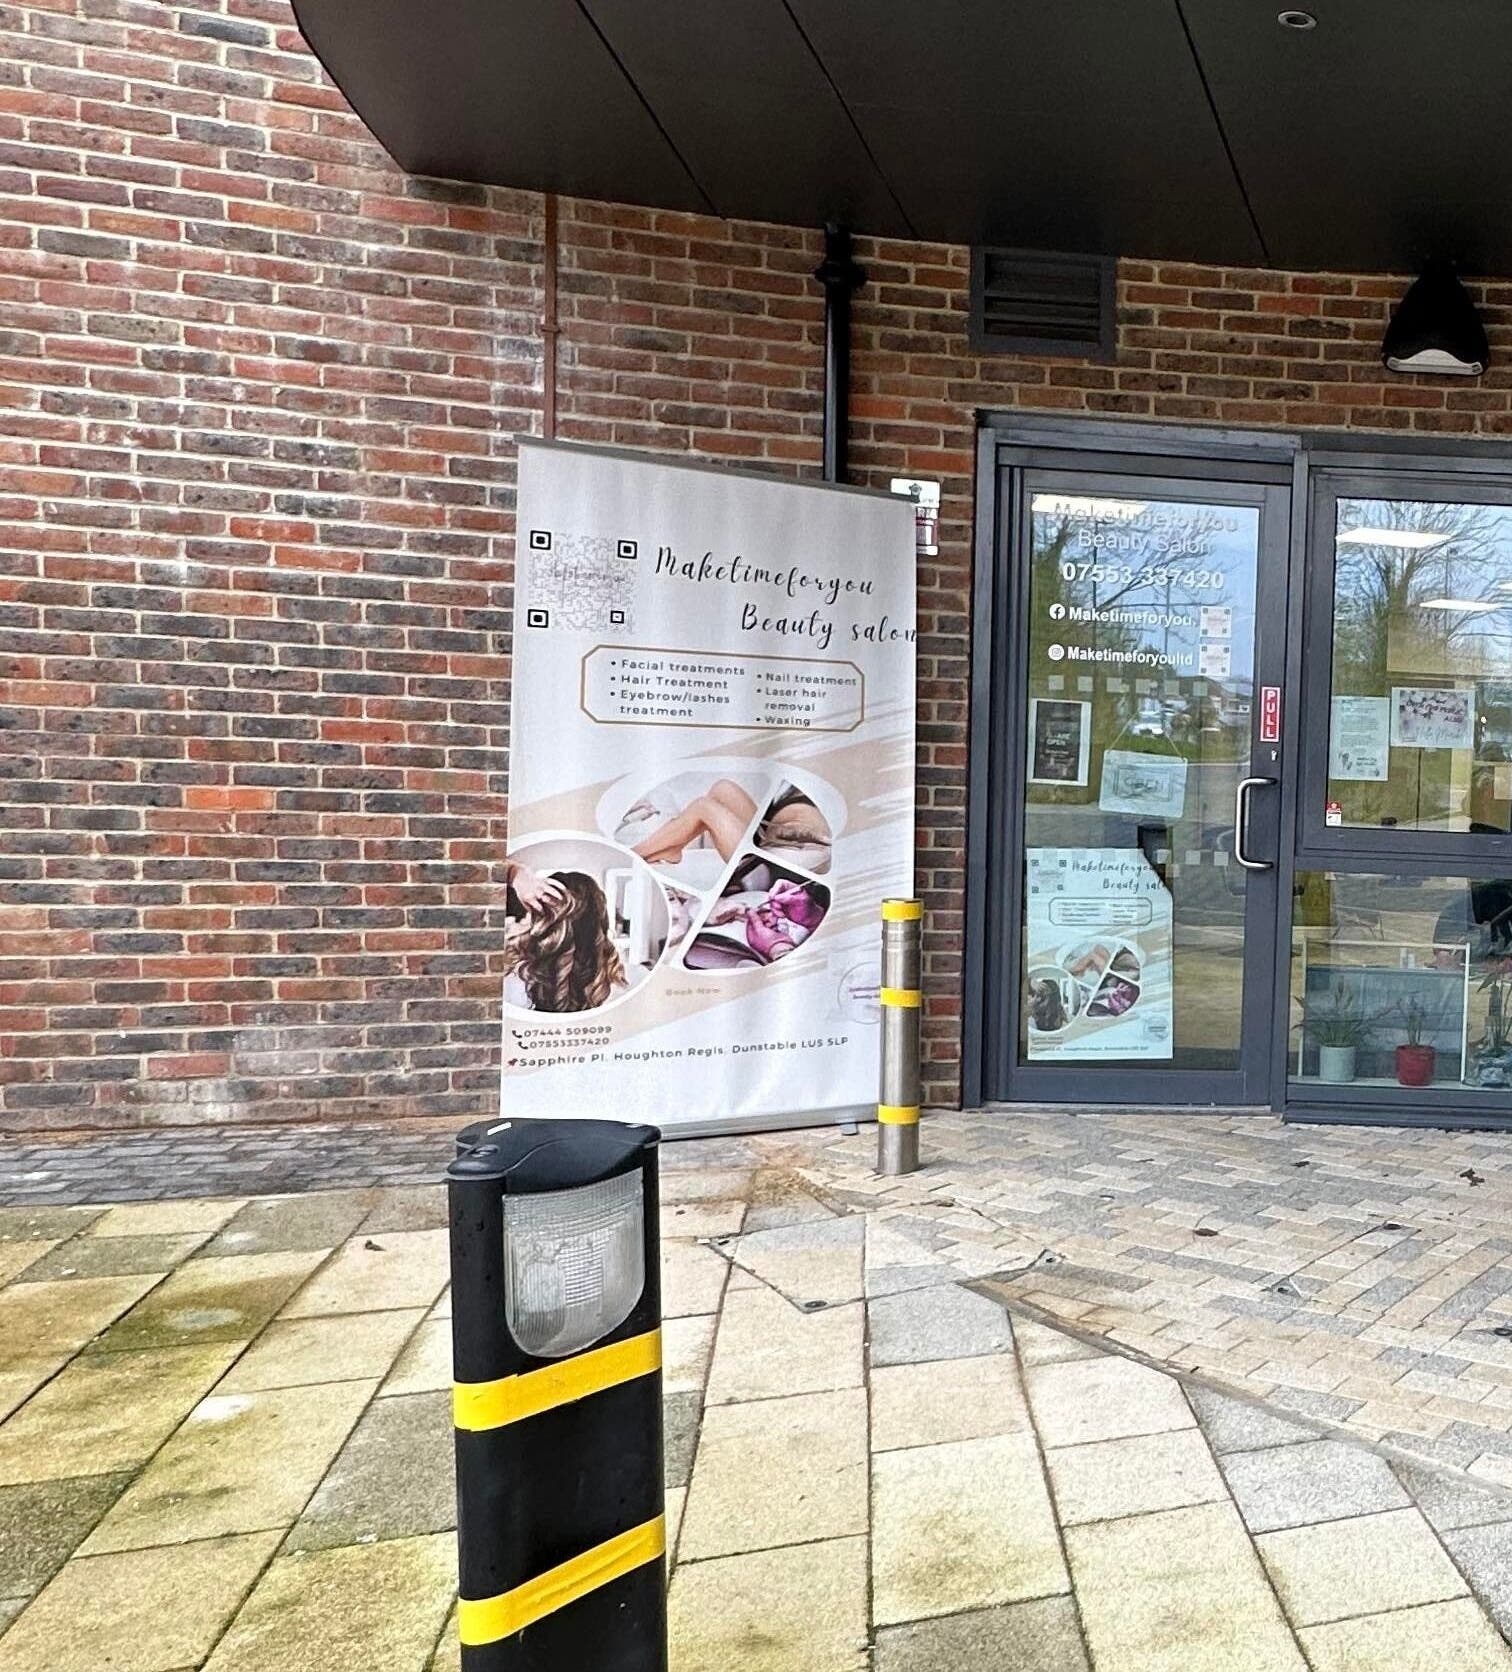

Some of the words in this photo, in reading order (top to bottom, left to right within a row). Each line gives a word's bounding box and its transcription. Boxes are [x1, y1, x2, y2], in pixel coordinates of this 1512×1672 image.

[1078, 529, 1148, 554] Beauty
[655, 546, 874, 605] Maketimeforyou
[1063, 562, 1133, 583] 07553
[1140, 566, 1224, 588] 337420
[741, 603, 834, 650] Beauty
[851, 615, 917, 643] salon
[621, 659, 664, 671] Facial
[669, 663, 745, 676] treatments
[621, 675, 651, 685] Hair
[656, 676, 728, 689] Treatment
[766, 672, 790, 683] Nail
[795, 674, 857, 686] treatment
[620, 689, 730, 704] Eyebrow/lashes
[765, 687, 798, 697] Laser
[802, 688, 827, 698] hair
[619, 705, 694, 717] treatment
[765, 702, 816, 712] removal
[1265, 690, 1276, 738] PULL
[764, 716, 811, 727] Waxing
[523, 1028, 562, 1038] 07444
[519, 1054, 586, 1068] Sapphire
[614, 1049, 683, 1061] Houghton
[732, 1040, 797, 1054] Dunstable
